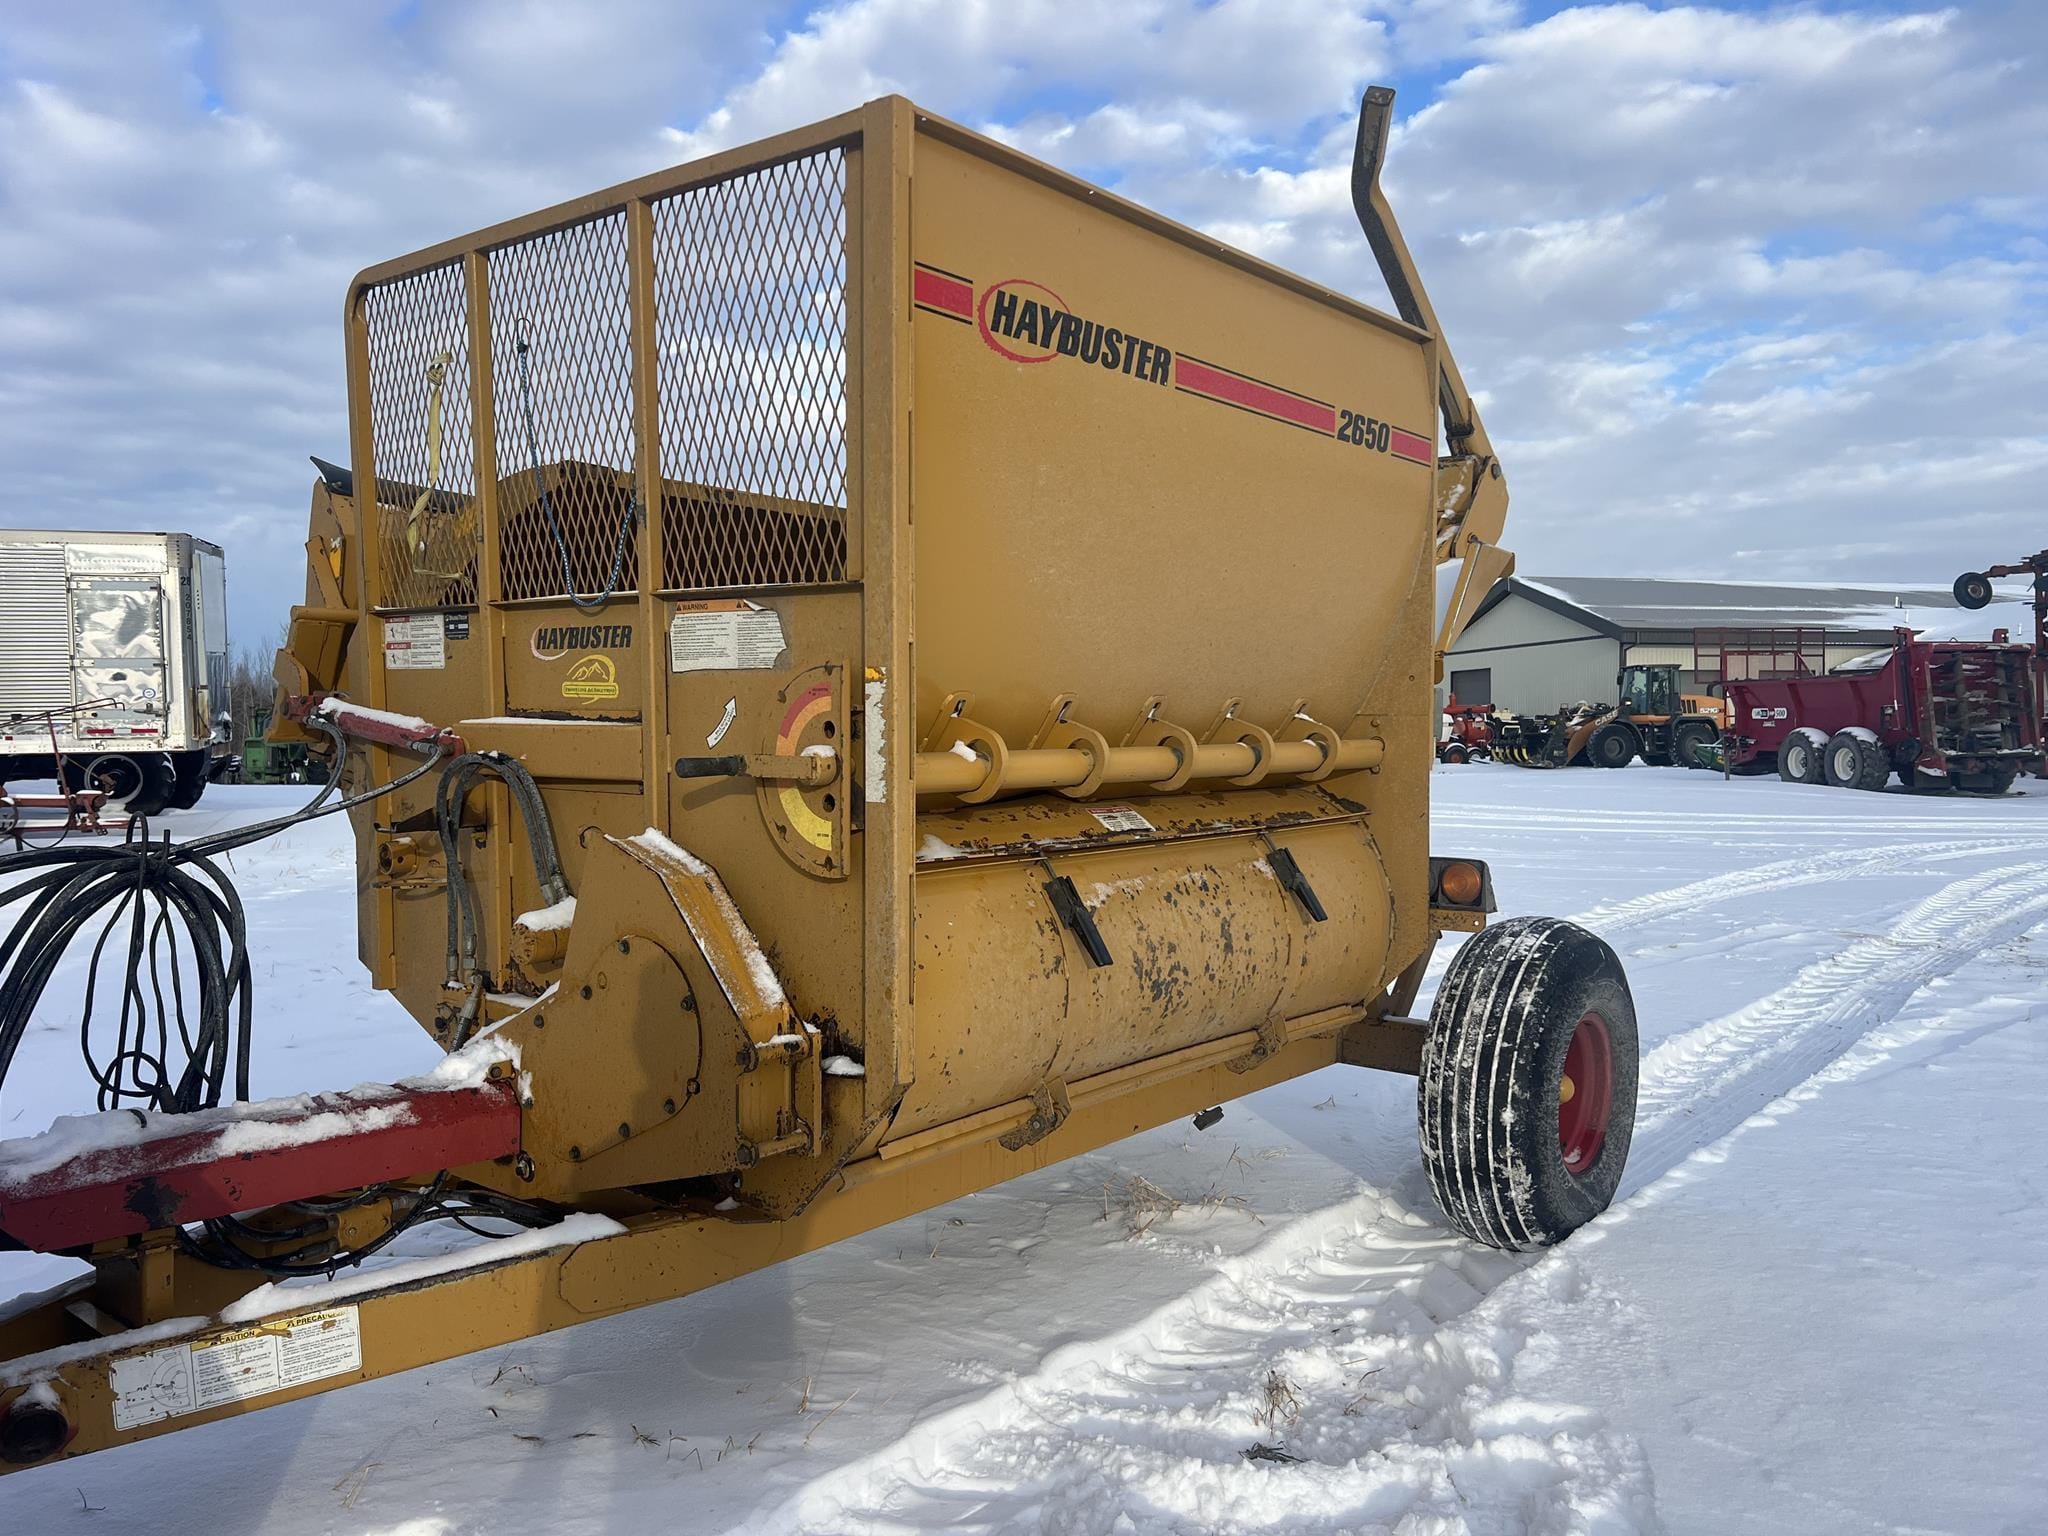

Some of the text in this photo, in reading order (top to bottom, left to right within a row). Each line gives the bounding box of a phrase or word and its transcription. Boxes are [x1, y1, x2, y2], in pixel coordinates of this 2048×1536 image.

[991, 290, 1172, 386] HAYBUSTER
[1336, 409, 1391, 454] 2650
[682, 603, 709, 611] WARNING
[536, 625, 633, 650] HAYBUSTER
[1595, 710, 1618, 726] CASE
[220, 1330, 255, 1344] CAUTION
